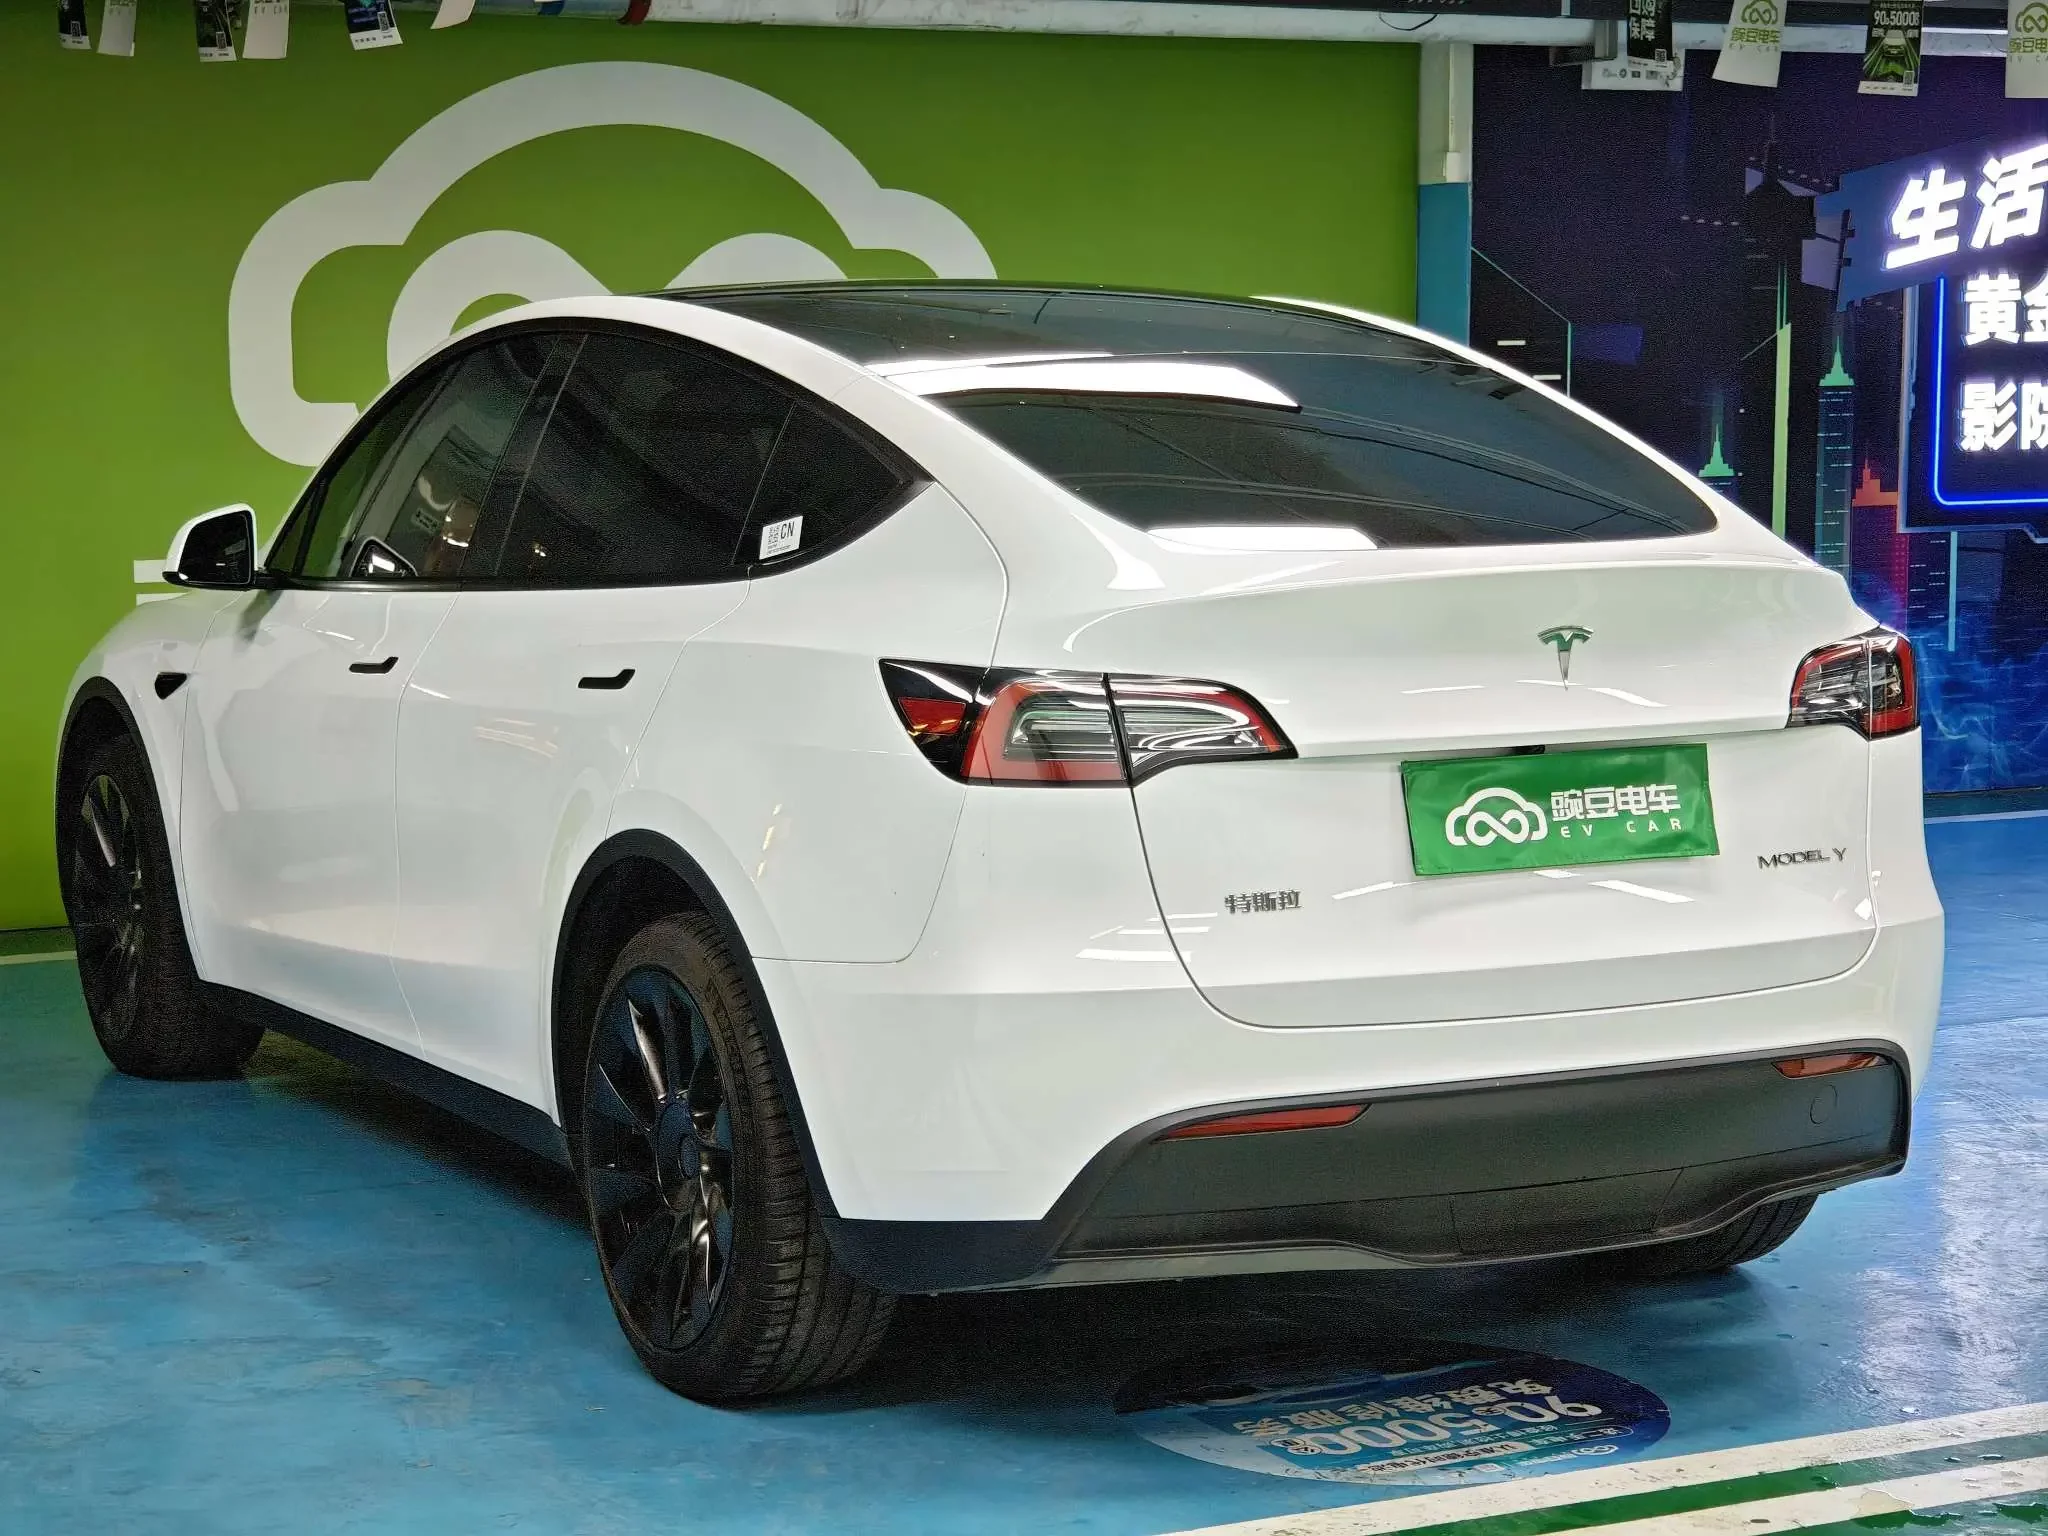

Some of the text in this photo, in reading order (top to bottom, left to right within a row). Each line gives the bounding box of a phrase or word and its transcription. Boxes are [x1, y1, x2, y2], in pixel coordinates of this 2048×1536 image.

[1885, 144, 2048, 270] 生活
[780, 521, 795, 539] CN
[1550, 784, 1681, 822] 豌豆电车
[1560, 818, 1682, 838] EV CAR
[1757, 847, 1847, 869] MODEL Y
[1224, 890, 1303, 915] 特斯拉
[1232, 1378, 1553, 1437] 免费维修服务
